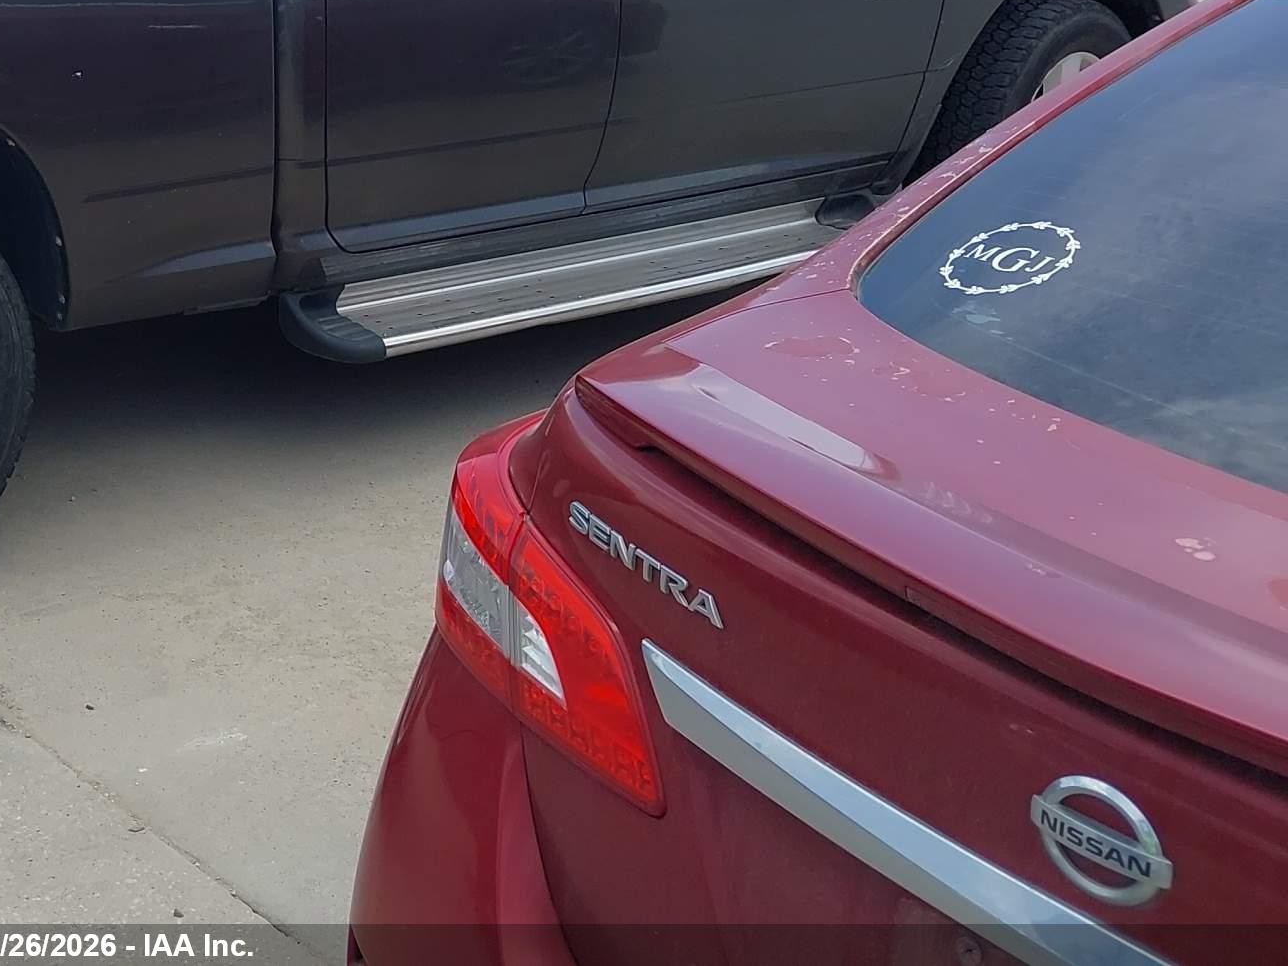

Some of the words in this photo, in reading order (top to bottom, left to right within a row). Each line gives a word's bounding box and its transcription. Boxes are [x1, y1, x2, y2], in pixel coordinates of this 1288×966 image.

[964, 244, 1055, 272] MGJ
[569, 500, 723, 629] SENTRA
[1041, 810, 1151, 877] NISSAN
